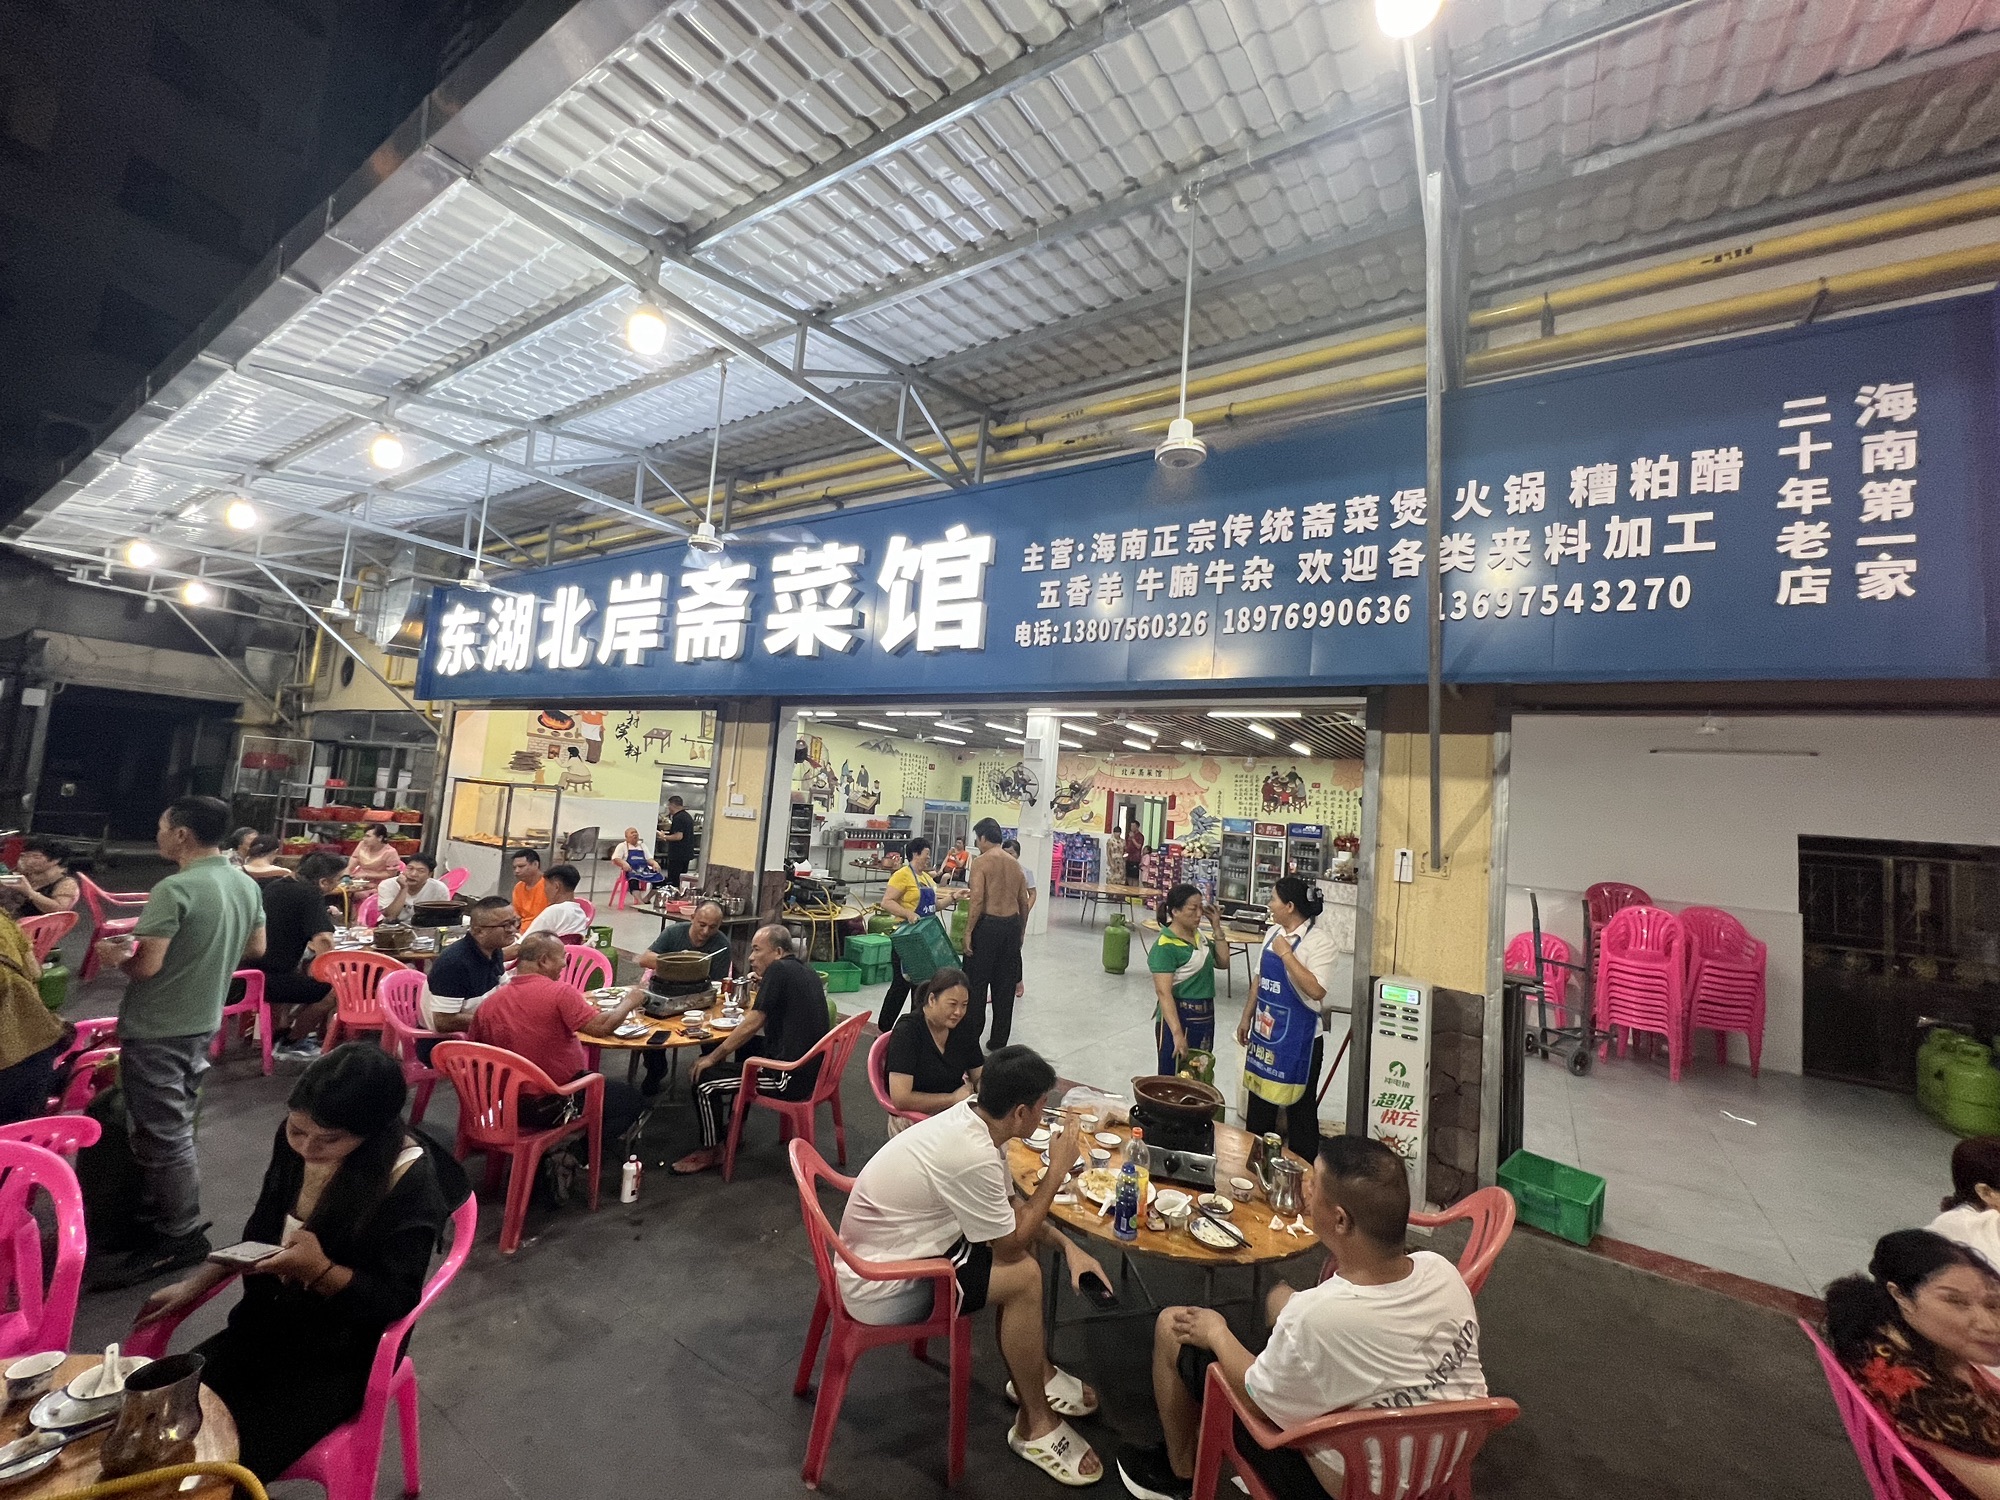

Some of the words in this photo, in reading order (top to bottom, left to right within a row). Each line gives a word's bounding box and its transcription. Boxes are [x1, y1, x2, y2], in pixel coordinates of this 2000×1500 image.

[1451, 471, 1547, 522] 火锅
[1568, 446, 1744, 509] 糟粕醋
[1776, 395, 1833, 605] 二十年老店
[1855, 382, 1918, 601] 海南第一家
[436, 524, 996, 677] 东湖北岸斋菜馆
[1036, 571, 1124, 610] 五香羊
[1136, 555, 1276, 602] 牛腩牛杂
[1222, 593, 1412, 635] 18976990636
[615, 710, 642, 763] 材实料
[1259, 976, 1282, 995] 郎酒
[1372, 1092, 1416, 1112] 超级
[1380, 1108, 1421, 1128] 快充
